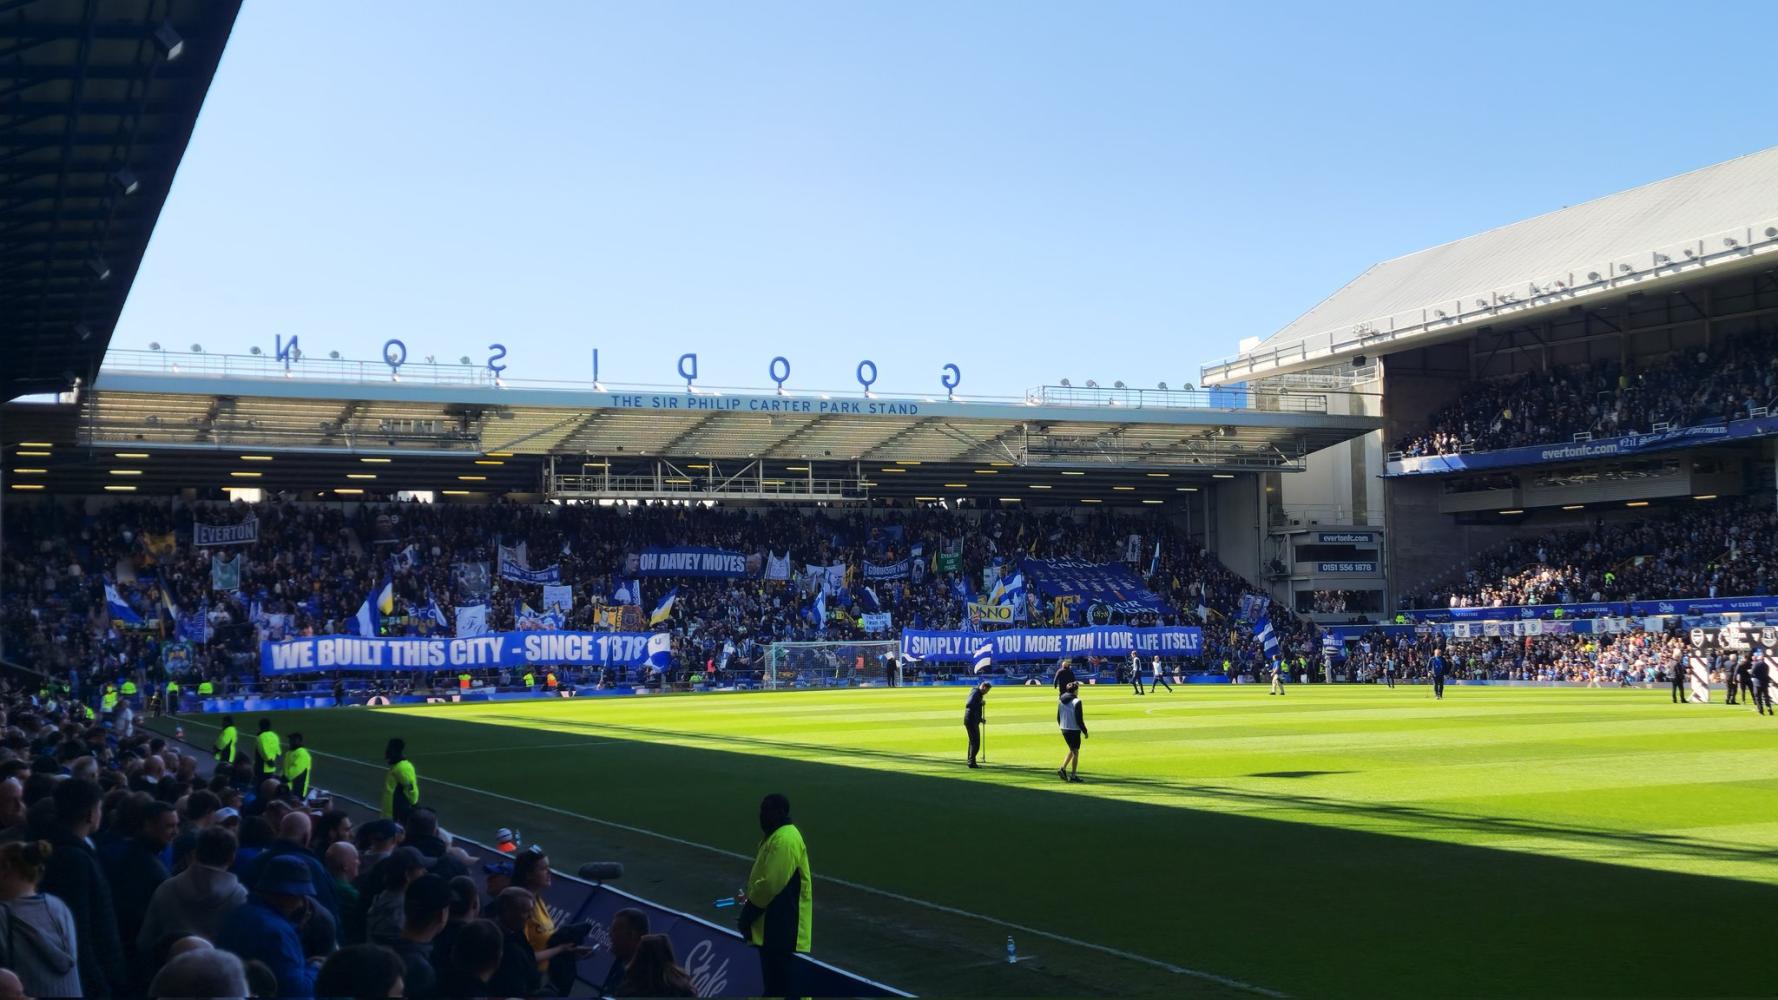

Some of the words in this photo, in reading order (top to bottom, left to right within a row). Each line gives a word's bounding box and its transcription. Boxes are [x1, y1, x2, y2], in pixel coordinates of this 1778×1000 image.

[612, 395, 643, 408] THE
[652, 397, 678, 408] SIR
[688, 399, 741, 410] PHILIP
[750, 399, 811, 412] CARTER
[820, 401, 860, 413] PARK
[869, 402, 918, 415] STAND
[1542, 443, 1617, 460] evertonfc.com
[201, 524, 255, 542] EVERTON
[1323, 534, 1369, 542] evertonfc.com
[640, 553, 658, 571] OH
[659, 553, 701, 570] DAVEY
[702, 553, 746, 573] MOYES
[1322, 563, 1338, 571] 0151
[1340, 563, 1354, 571] 556
[1355, 563, 1372, 571] 1878
[969, 605, 1011, 620] NSNO
[912, 636, 962, 654] SIMPLY
[965, 637, 993, 654] LO
[997, 635, 1020, 653] YOU
[1025, 634, 1062, 653] MORE
[1066, 632, 1094, 651] THAN
[1098, 632, 1102, 648] I
[1105, 632, 1133, 649] LOVE
[1136, 633, 1159, 650] LIFE
[1162, 633, 1198, 650] ITSELF
[271, 641, 314, 670] WE
[317, 638, 385, 666] BUILT
[388, 641, 445, 666] THIS
[450, 637, 504, 665] CITY
[525, 635, 593, 661] SINCE
